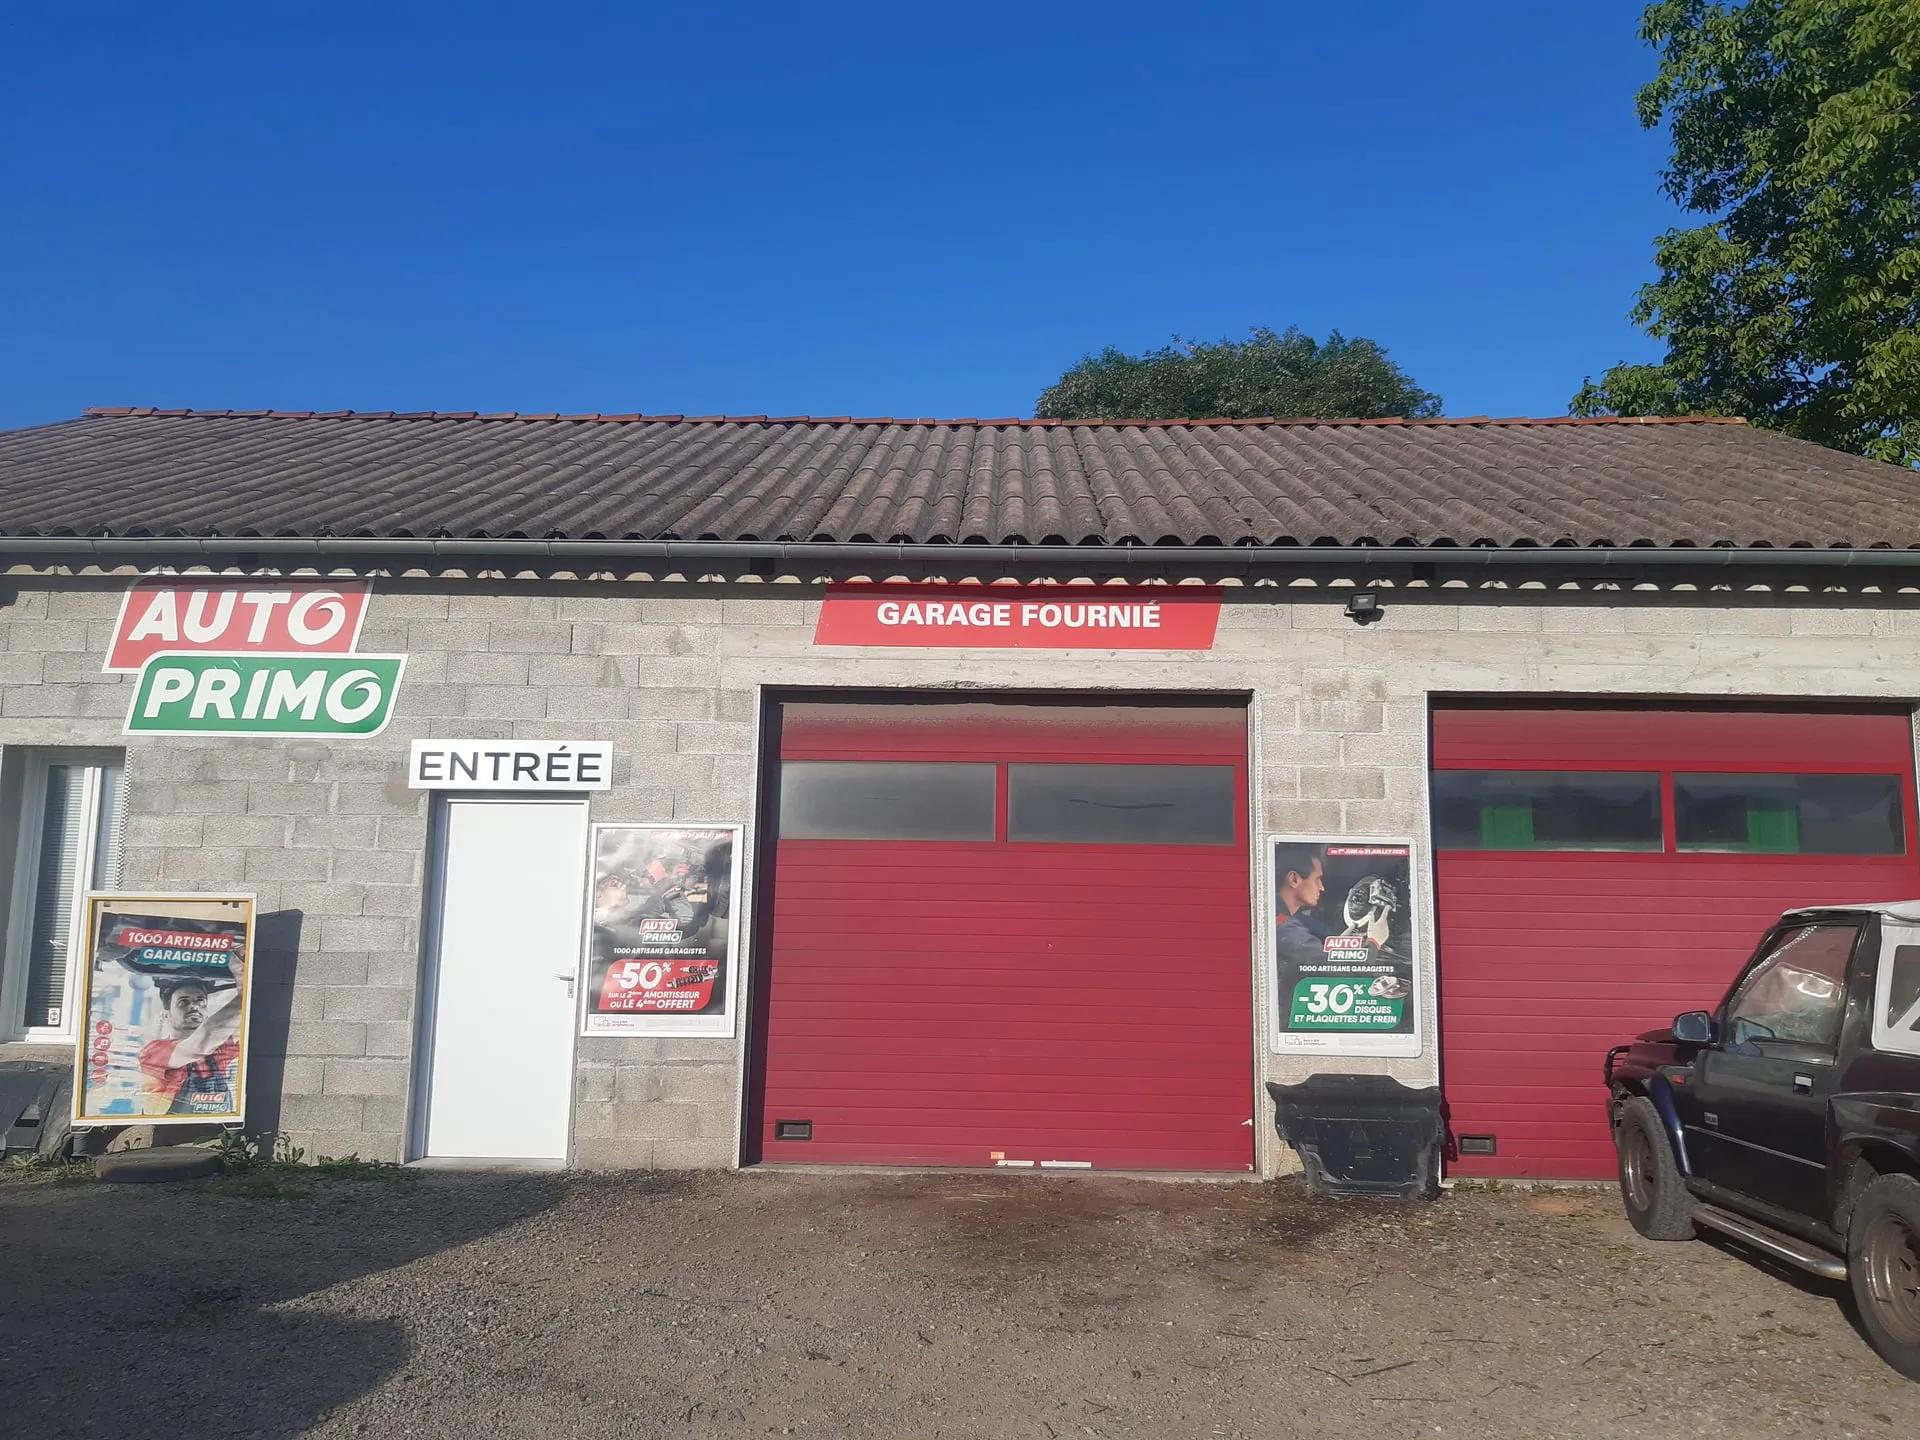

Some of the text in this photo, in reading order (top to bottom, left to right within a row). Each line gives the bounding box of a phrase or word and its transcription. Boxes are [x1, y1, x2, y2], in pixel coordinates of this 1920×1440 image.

[127, 589, 346, 646] AUTO
[877, 600, 1160, 628] GARAGE FOURNIÉ
[144, 668, 382, 724] PRIMO
[419, 745, 602, 782] ENTRÉE
[643, 921, 674, 930] AUTO
[128, 932, 230, 949] 1000 ARTISANS
[644, 932, 680, 942] PRIMO
[1326, 938, 1360, 948] AUTO
[631, 947, 664, 955] ARTISANS
[664, 947, 707, 955] GARAGISTES
[1330, 950, 1366, 960] PRIMO
[143, 949, 227, 964] GARAGISTES
[1299, 965, 1395, 973] 1000 ARTISANS GARAGISTES
[644, 991, 700, 999] AMORTISSEUR
[622, 999, 635, 1008] LE
[656, 1000, 696, 1009] OFFERT
[1354, 1005, 1392, 1014] DISQUES
[1294, 1014, 1398, 1024] ET PLAQUETTES DE FREIN
[193, 1093, 223, 1101] AUTO
[195, 1103, 227, 1111] PRIMO
